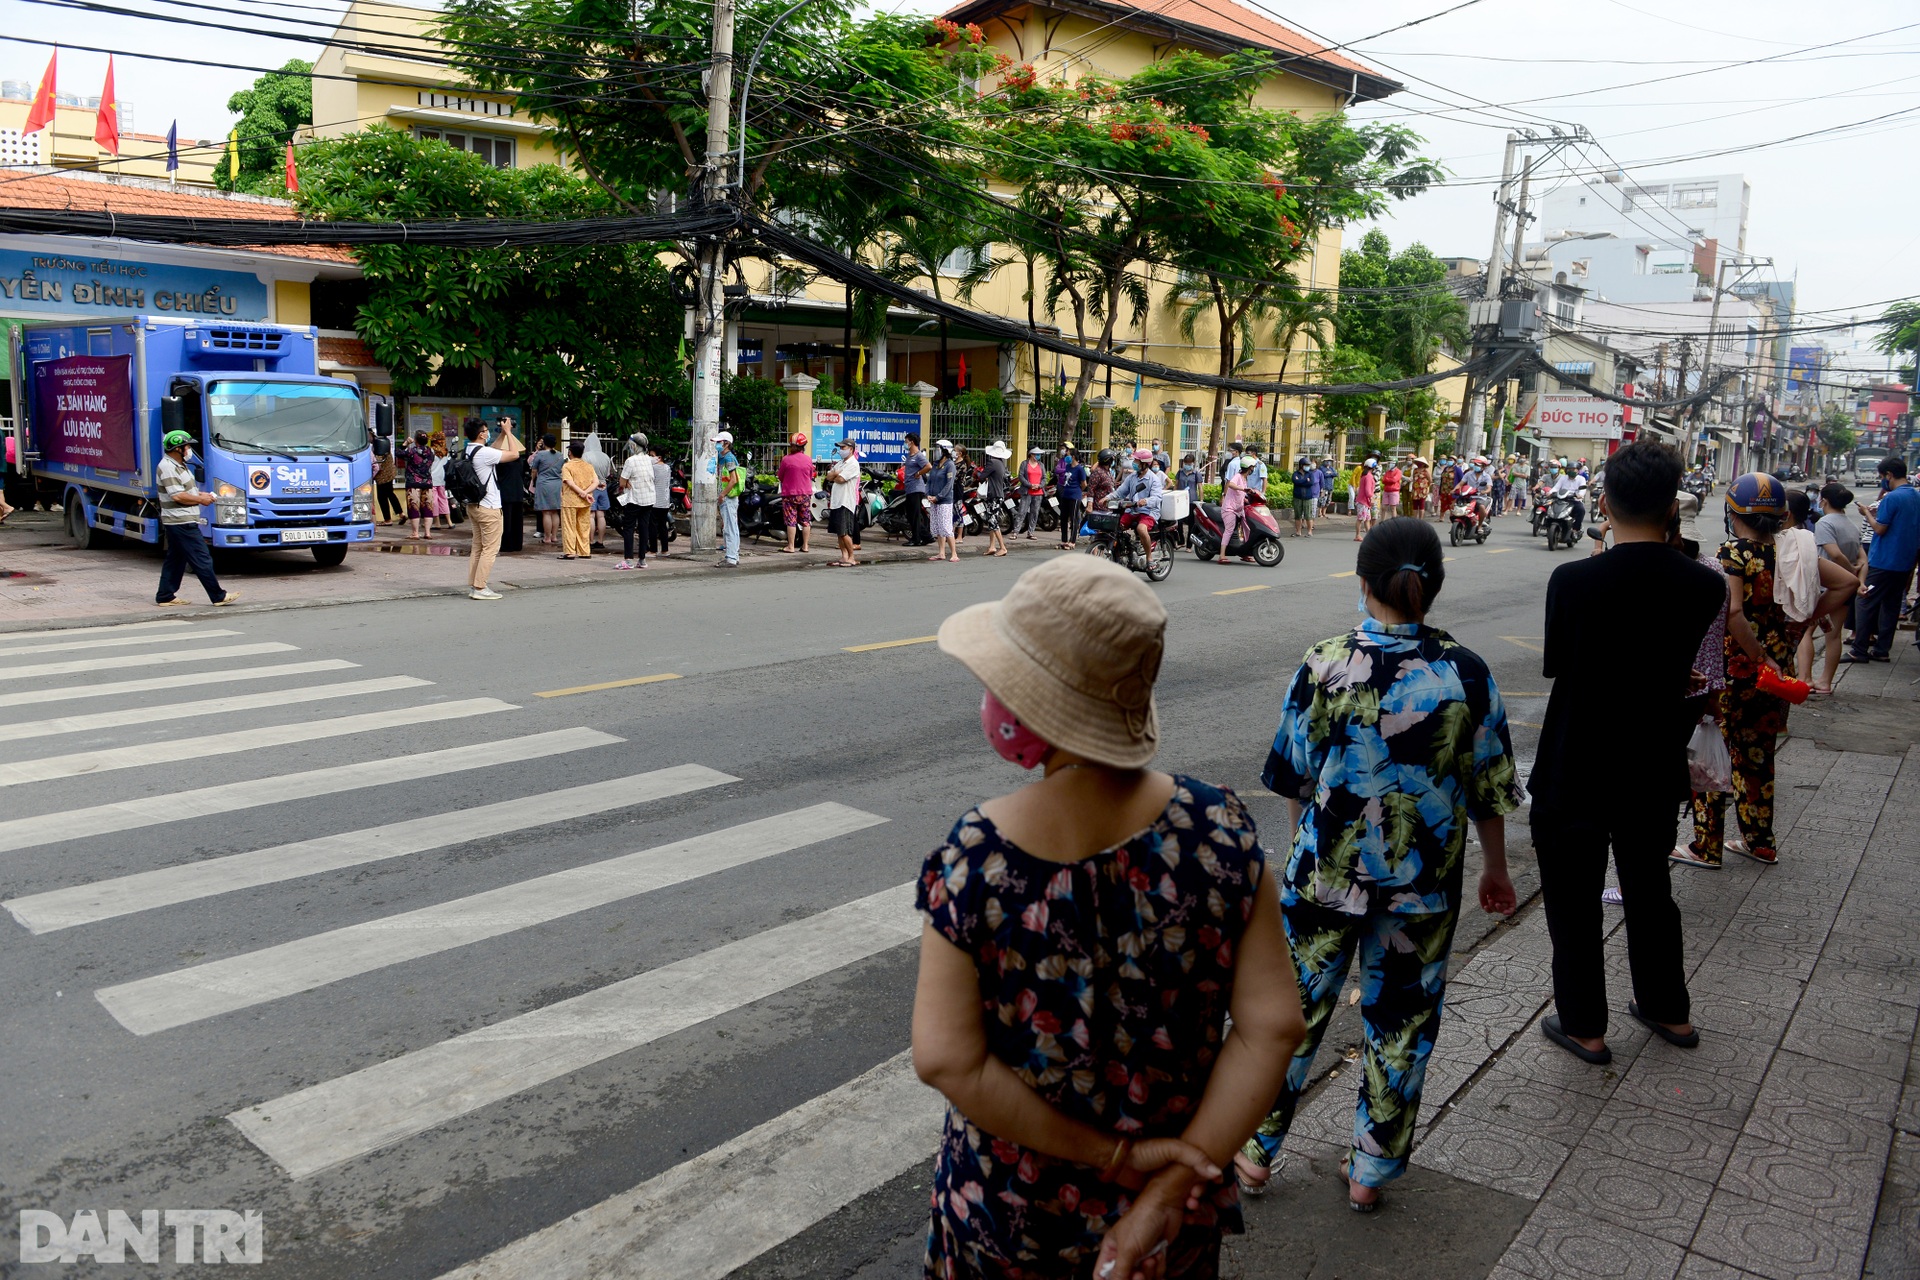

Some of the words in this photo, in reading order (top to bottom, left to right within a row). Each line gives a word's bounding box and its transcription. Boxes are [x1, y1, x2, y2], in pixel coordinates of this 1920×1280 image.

[32, 256, 87, 271] TRƯỜNG
[91, 259, 117, 275] TIỂU
[119, 263, 148, 278] HỌC
[73, 279, 146, 308] ĐÌNH
[154, 285, 238, 315] CHIỂU
[84, 391, 107, 412] HÀNG
[1541, 408, 1573, 423] ĐỨC
[1578, 412, 1609, 427] THỌ
[63, 418, 78, 437] LƯU
[79, 417, 102, 442] ĐỘNG
[882, 431, 896, 441] GIAO
